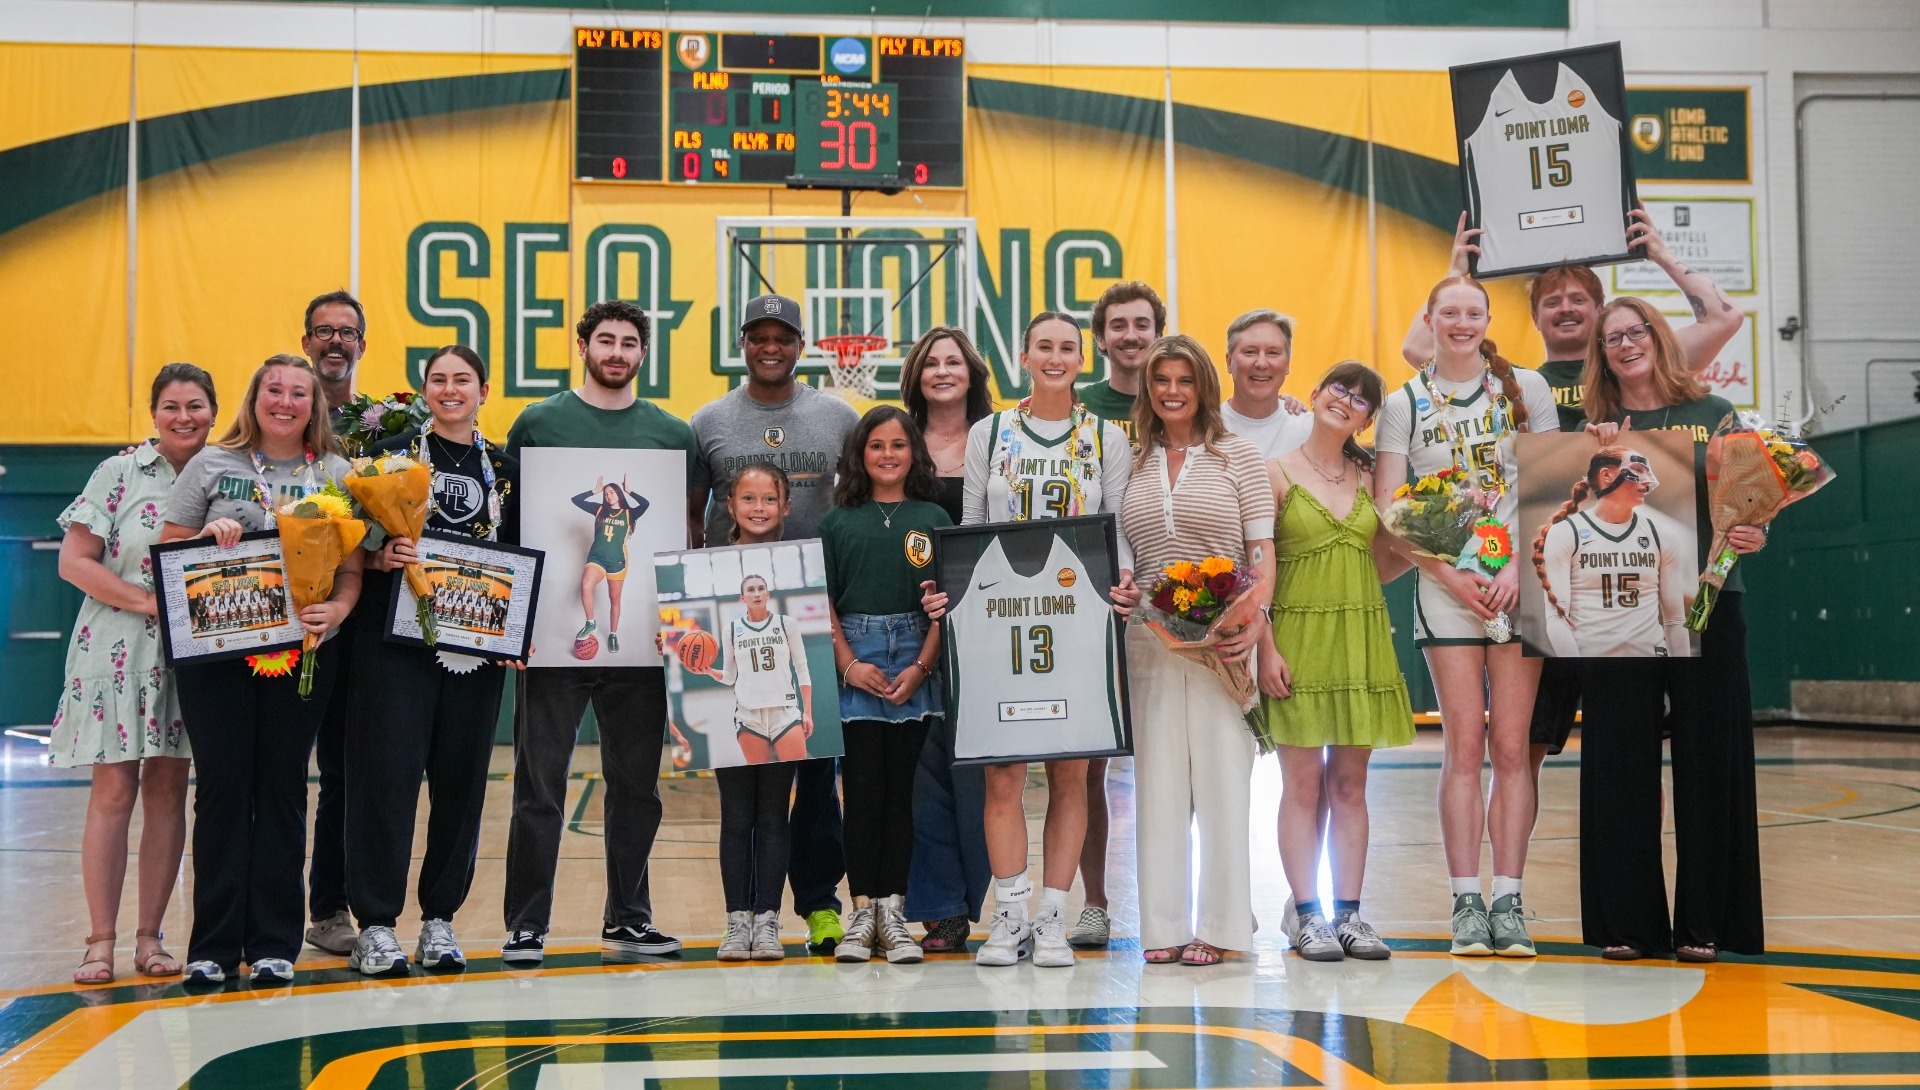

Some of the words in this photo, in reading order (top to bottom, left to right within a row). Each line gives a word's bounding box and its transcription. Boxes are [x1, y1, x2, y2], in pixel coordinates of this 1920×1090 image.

[577, 29, 605, 48] PLY
[611, 30, 629, 48] FL
[632, 30, 662, 49] PTS
[881, 37, 906, 56] PLY
[912, 38, 931, 56] FL
[933, 38, 962, 56] PTS
[693, 71, 729, 90] PLNU
[752, 82, 790, 95] PERIOD
[773, 98, 779, 121] 1
[826, 89, 890, 118] 3:44
[1670, 107, 1706, 125] LOMA
[1504, 119, 1547, 141] POINT
[1549, 114, 1590, 136] LOMA
[1670, 126, 1728, 144] ATHLETIC
[674, 131, 702, 149] FLS
[733, 132, 769, 150] PLYR
[820, 120, 877, 170] 30
[1671, 144, 1704, 162] FUND
[612, 157, 627, 178] 0
[683, 152, 701, 180] 0
[714, 160, 728, 177] 4
[1529, 142, 1573, 190] 15
[406, 221, 693, 397] SEA
[1422, 419, 1470, 447] PONT
[781, 451, 828, 472] LOMA
[603, 525, 614, 542] 4
[1488, 540, 1498, 552] 15
[1579, 552, 1618, 569] POINT
[1622, 552, 1656, 568] LOMA
[1601, 573, 1640, 608] 15
[986, 596, 1031, 618] POINT
[1034, 594, 1077, 616] LOMA
[738, 638, 760, 650] POINT
[762, 636, 784, 646] LOMA
[1011, 624, 1055, 675] 13
[750, 646, 775, 672] 13
